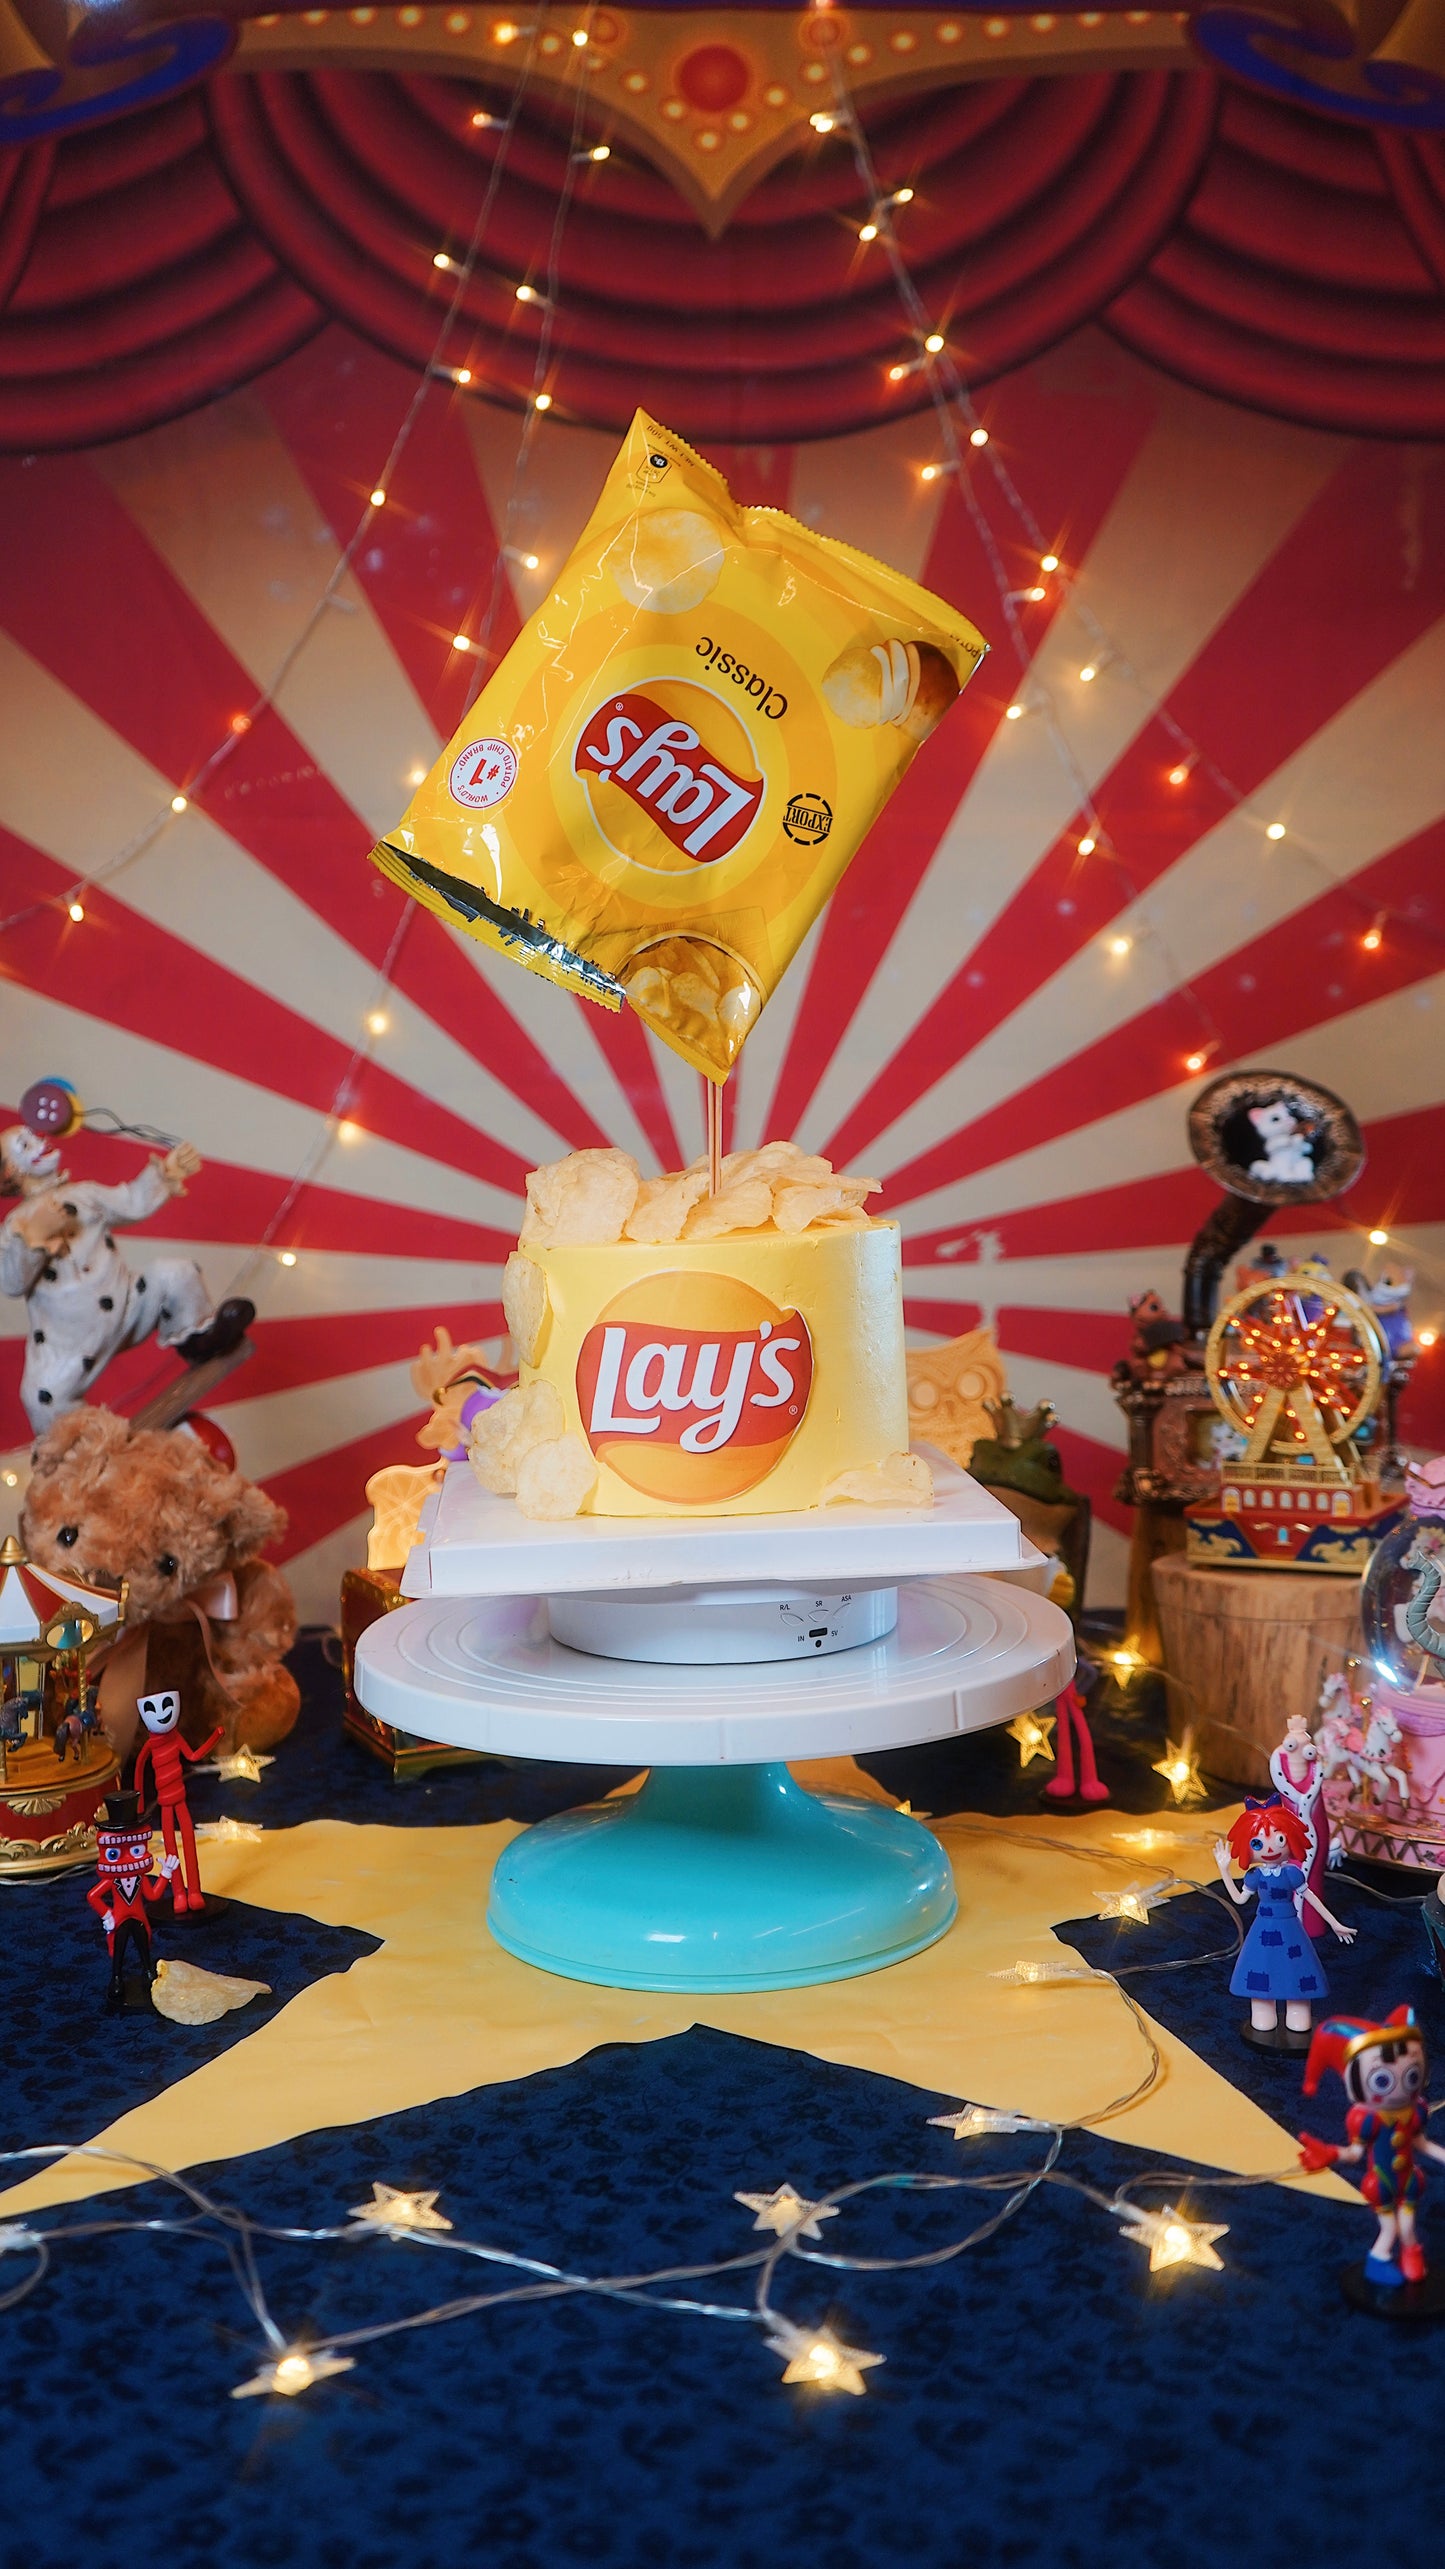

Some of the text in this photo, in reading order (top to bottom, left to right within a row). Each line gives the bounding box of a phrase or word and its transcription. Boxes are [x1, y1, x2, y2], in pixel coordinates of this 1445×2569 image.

[695, 636, 788, 720] Classic
[458, 743, 513, 788] POTATO CHIP BRAND
[468, 758, 501, 786] #1
[585, 716, 756, 856] Lay's
[457, 784, 489, 803] WORLD'S
[782, 806, 833, 833] EXPORT
[589, 1320, 801, 1454] Lay's
